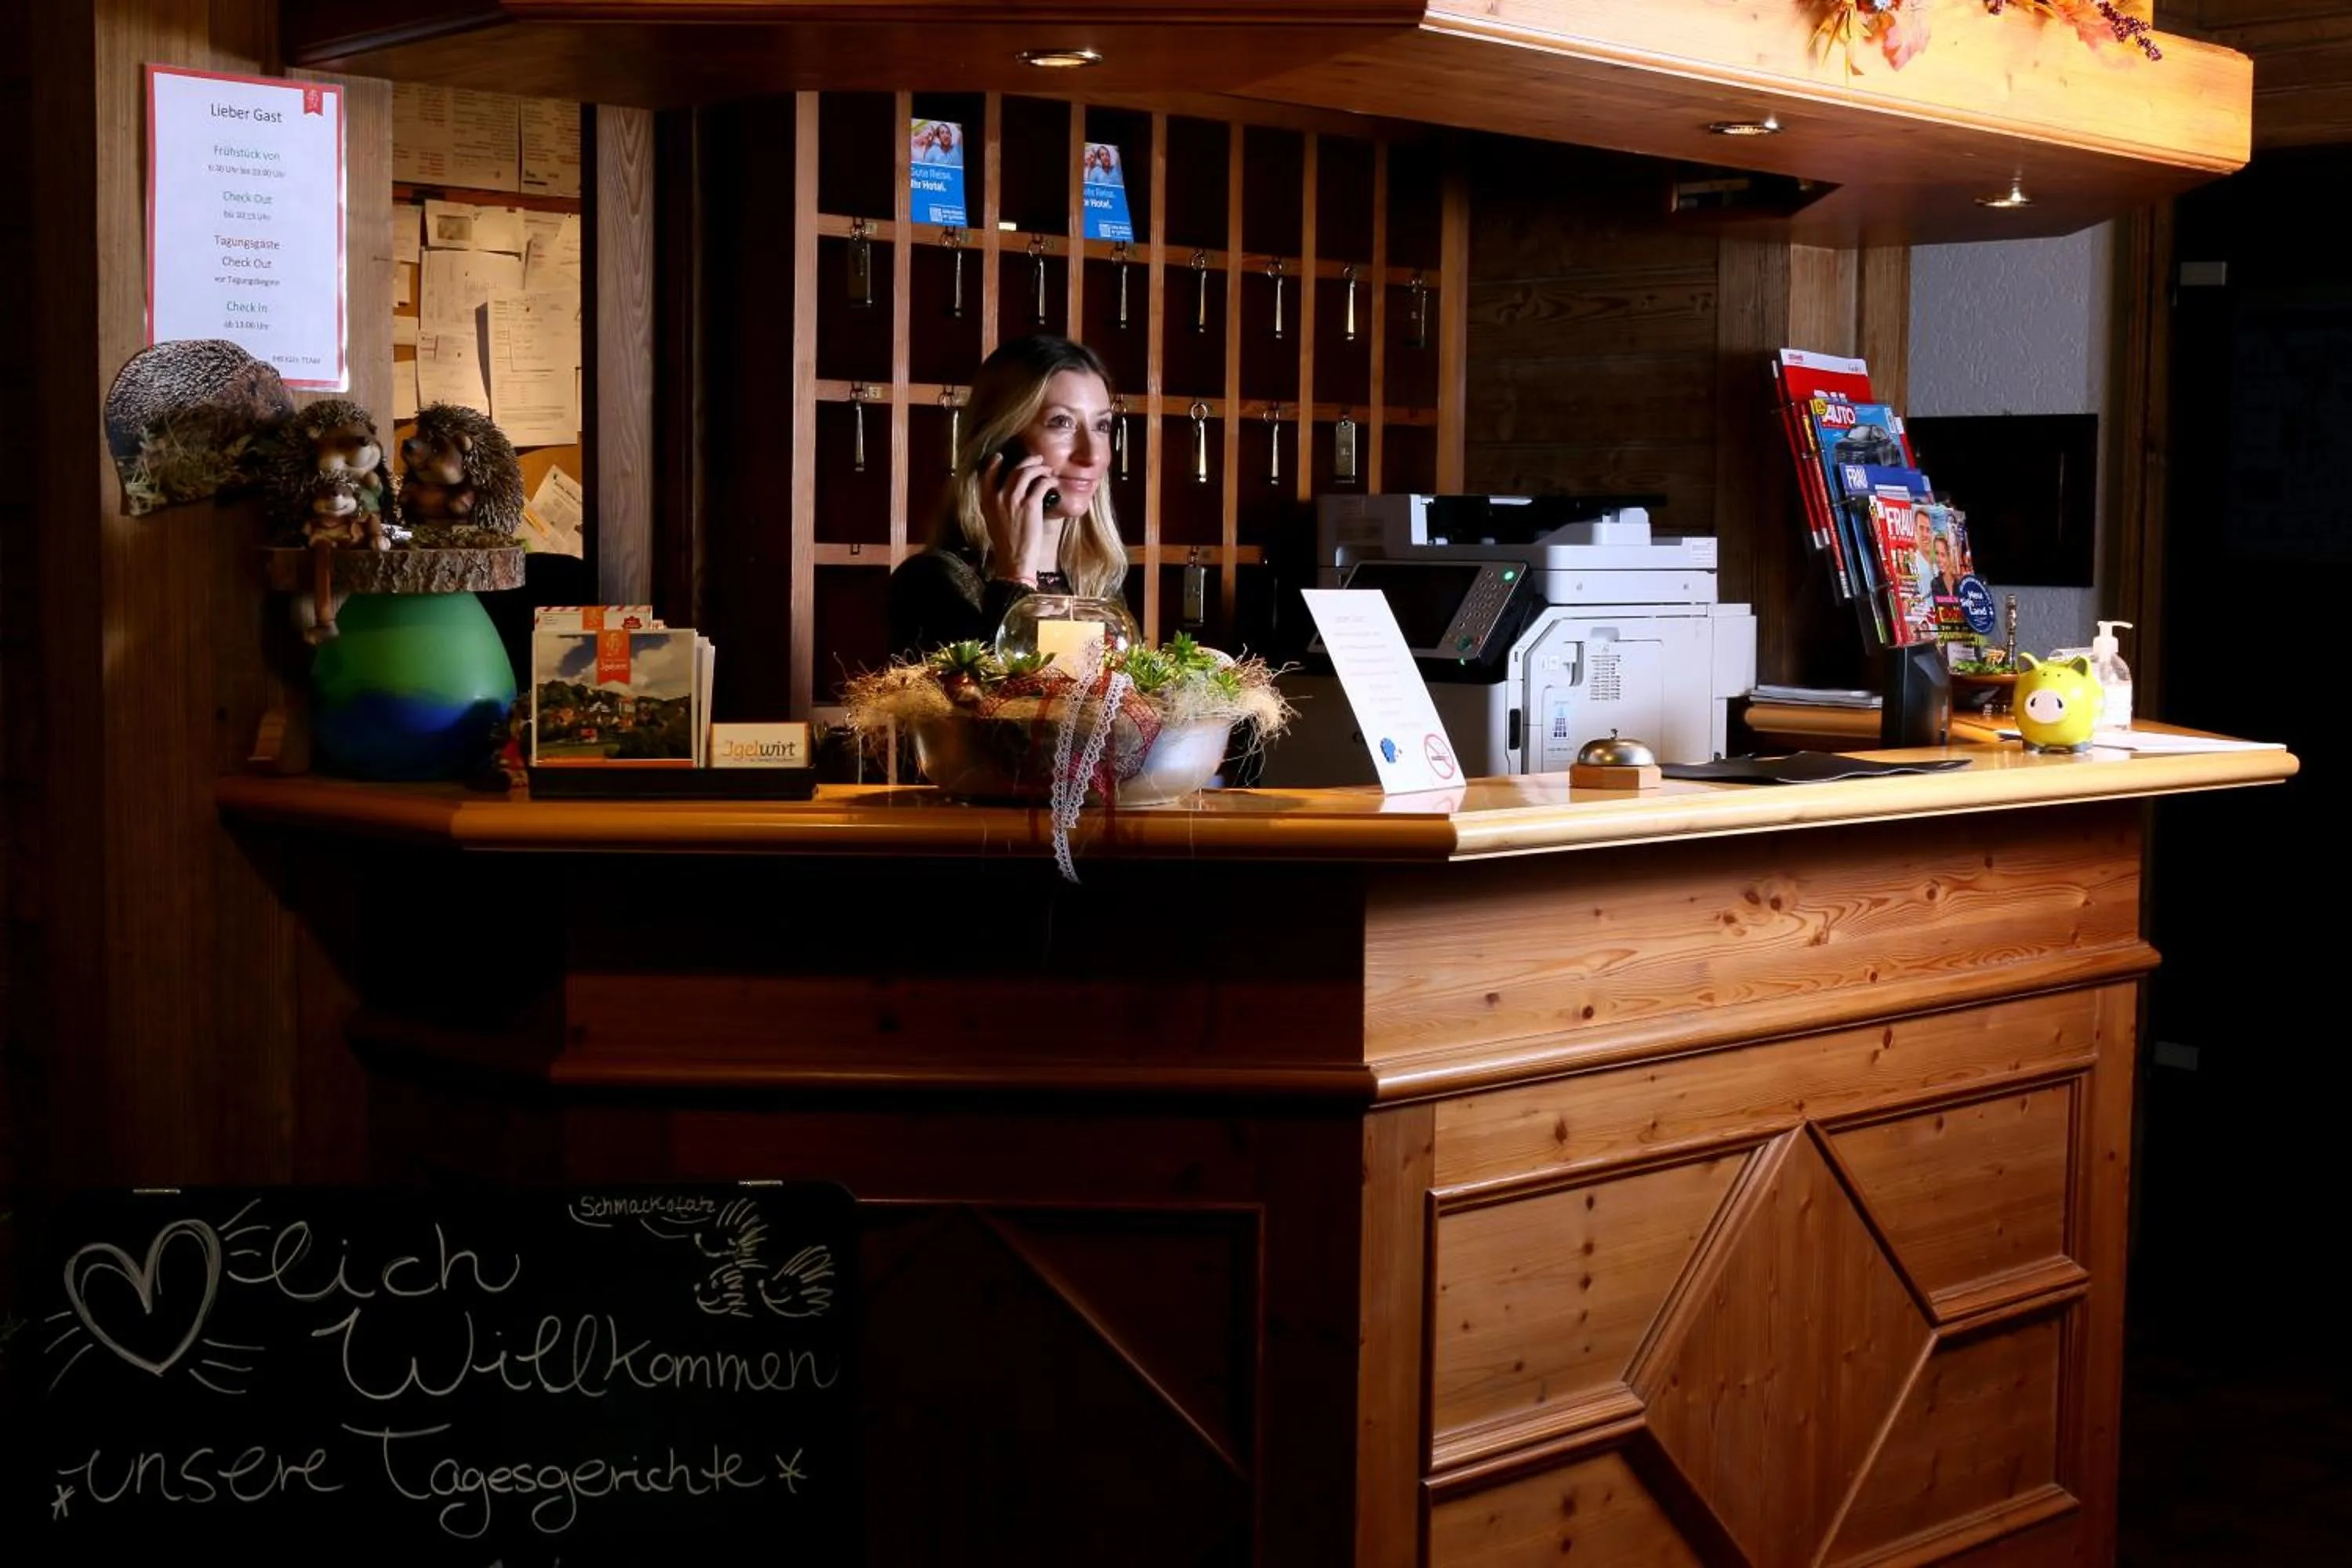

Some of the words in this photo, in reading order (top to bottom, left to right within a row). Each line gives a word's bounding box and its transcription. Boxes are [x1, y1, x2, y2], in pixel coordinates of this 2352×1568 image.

[210, 103, 250, 120] Lieber
[253, 107, 283, 123] Gast
[222, 191, 252, 203] Check
[253, 193, 273, 205] Out
[221, 255, 252, 267] Check
[253, 257, 272, 269] Out
[226, 300, 255, 313] Check
[1822, 404, 1856, 425] AUTO
[1886, 507, 1915, 537] FRAU
[227, 1220, 521, 1301] lich
[312, 1306, 840, 1400] Willkommen
[341, 1422, 766, 1539] Tagesgerichte
